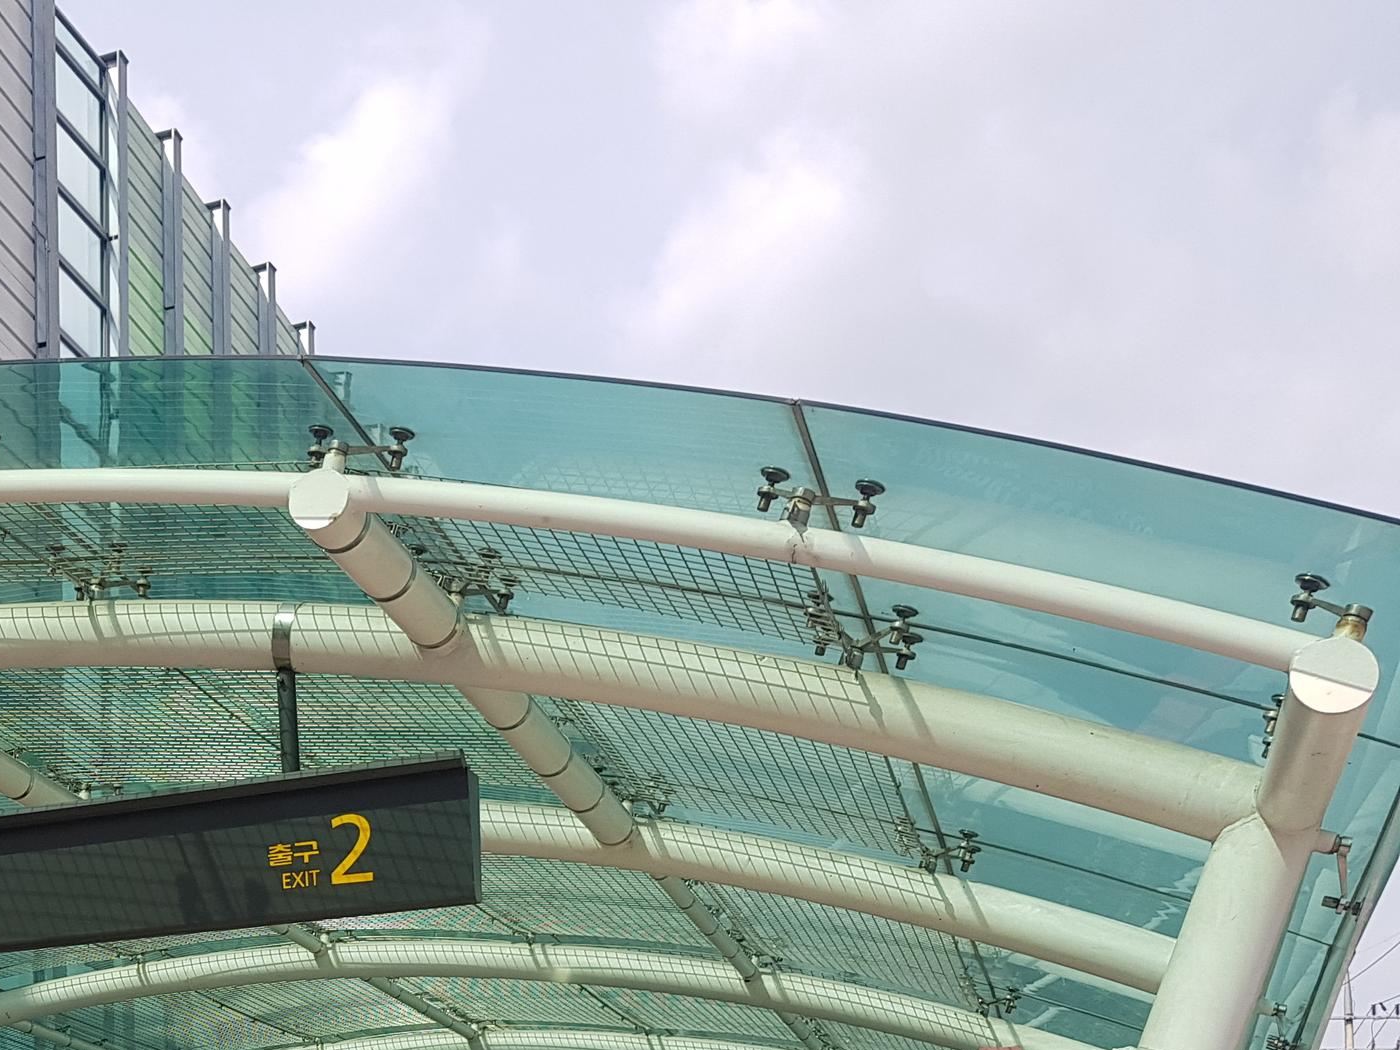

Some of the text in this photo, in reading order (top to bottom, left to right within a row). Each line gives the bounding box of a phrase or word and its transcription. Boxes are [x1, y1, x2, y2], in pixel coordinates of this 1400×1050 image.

[267, 839, 320, 868] 출구
[331, 813, 374, 885] 2
[282, 869, 320, 889] EXIT
